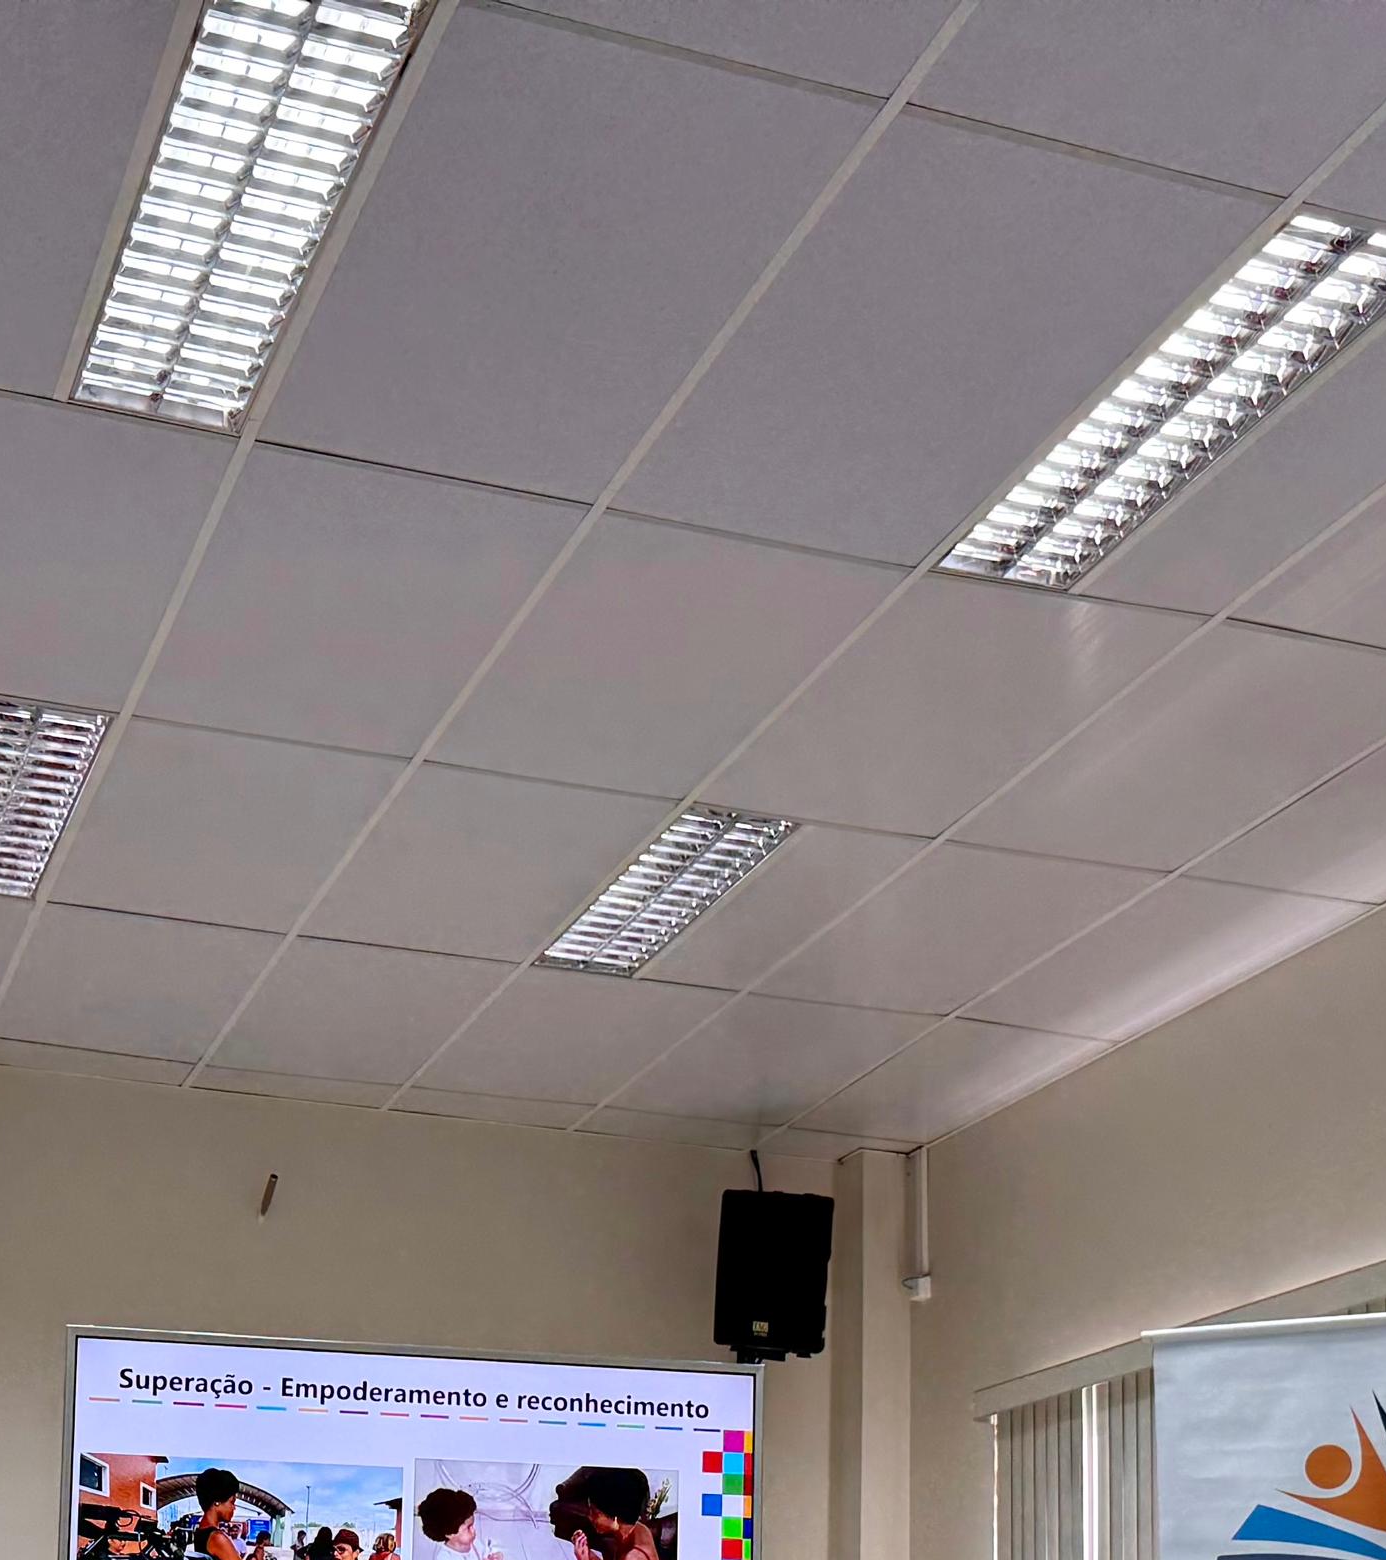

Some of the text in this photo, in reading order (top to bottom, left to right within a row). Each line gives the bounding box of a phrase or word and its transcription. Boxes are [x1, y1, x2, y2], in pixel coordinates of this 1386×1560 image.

[118, 1368, 254, 1401] Superação
[280, 1376, 488, 1409] Empoderamento
[495, 1392, 509, 1409] e
[517, 1392, 710, 1419] reconhecimento
